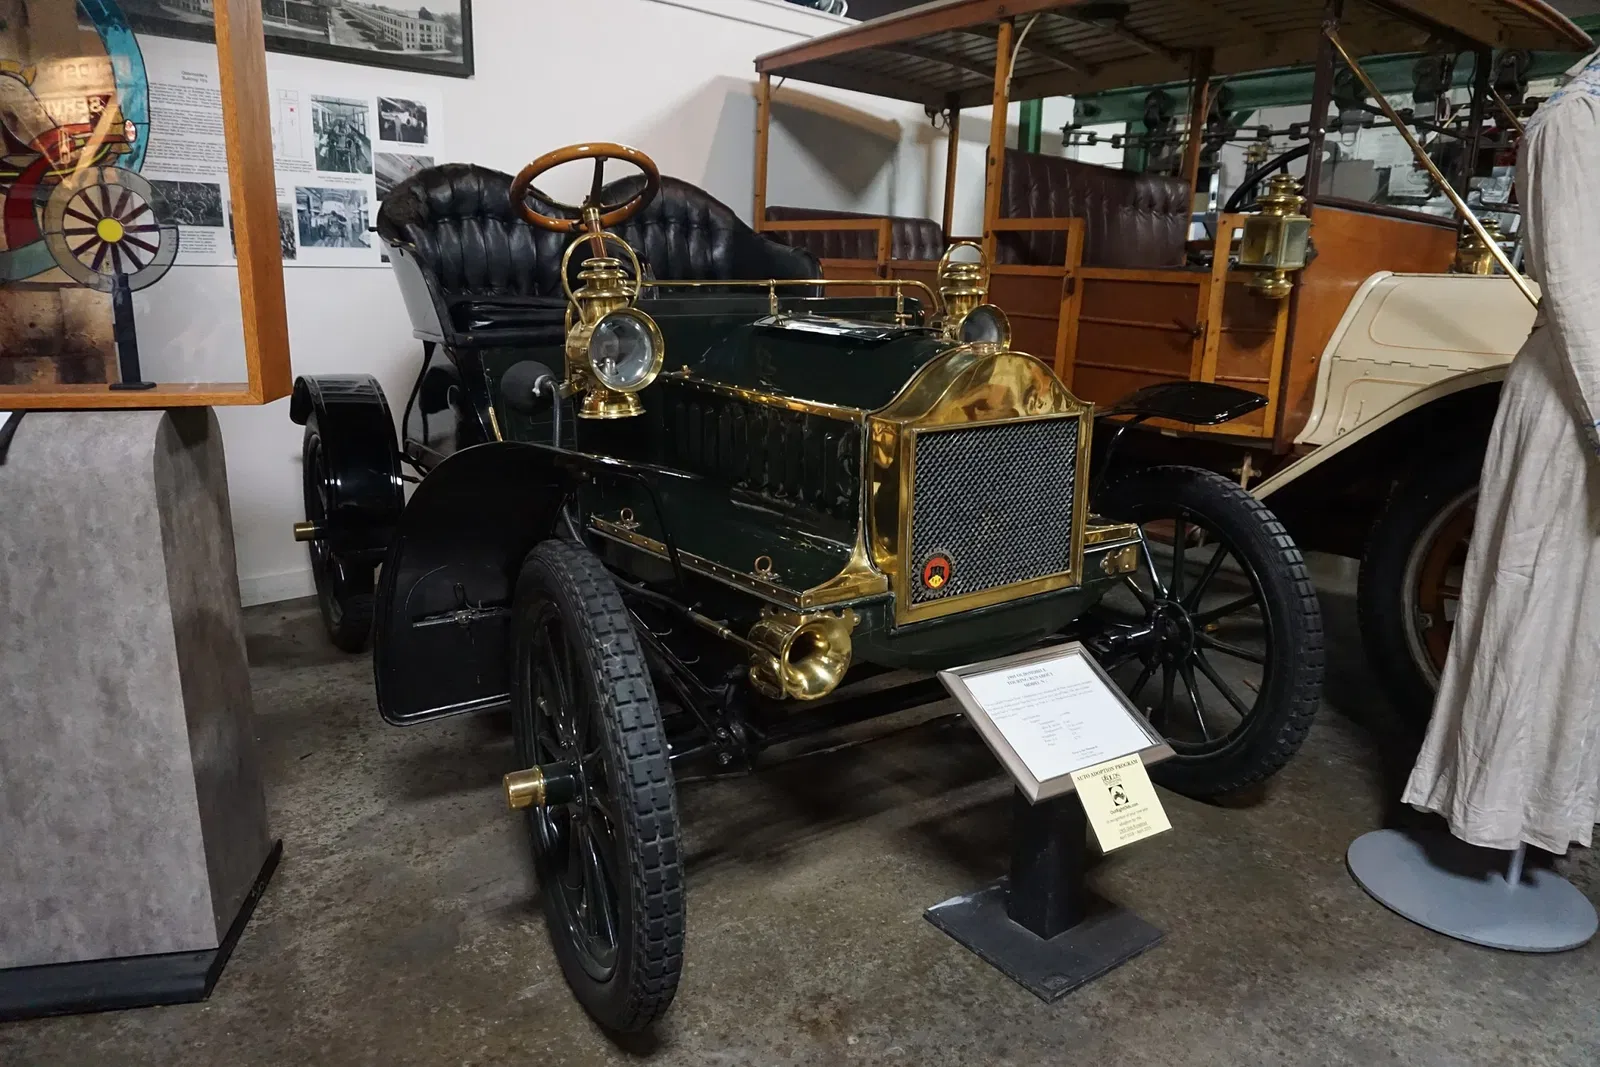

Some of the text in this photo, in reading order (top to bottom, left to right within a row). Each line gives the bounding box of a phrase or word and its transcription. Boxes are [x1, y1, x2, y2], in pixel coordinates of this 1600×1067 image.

[1077, 759, 1138, 781] AUTO ADOPTION PROGRAM
